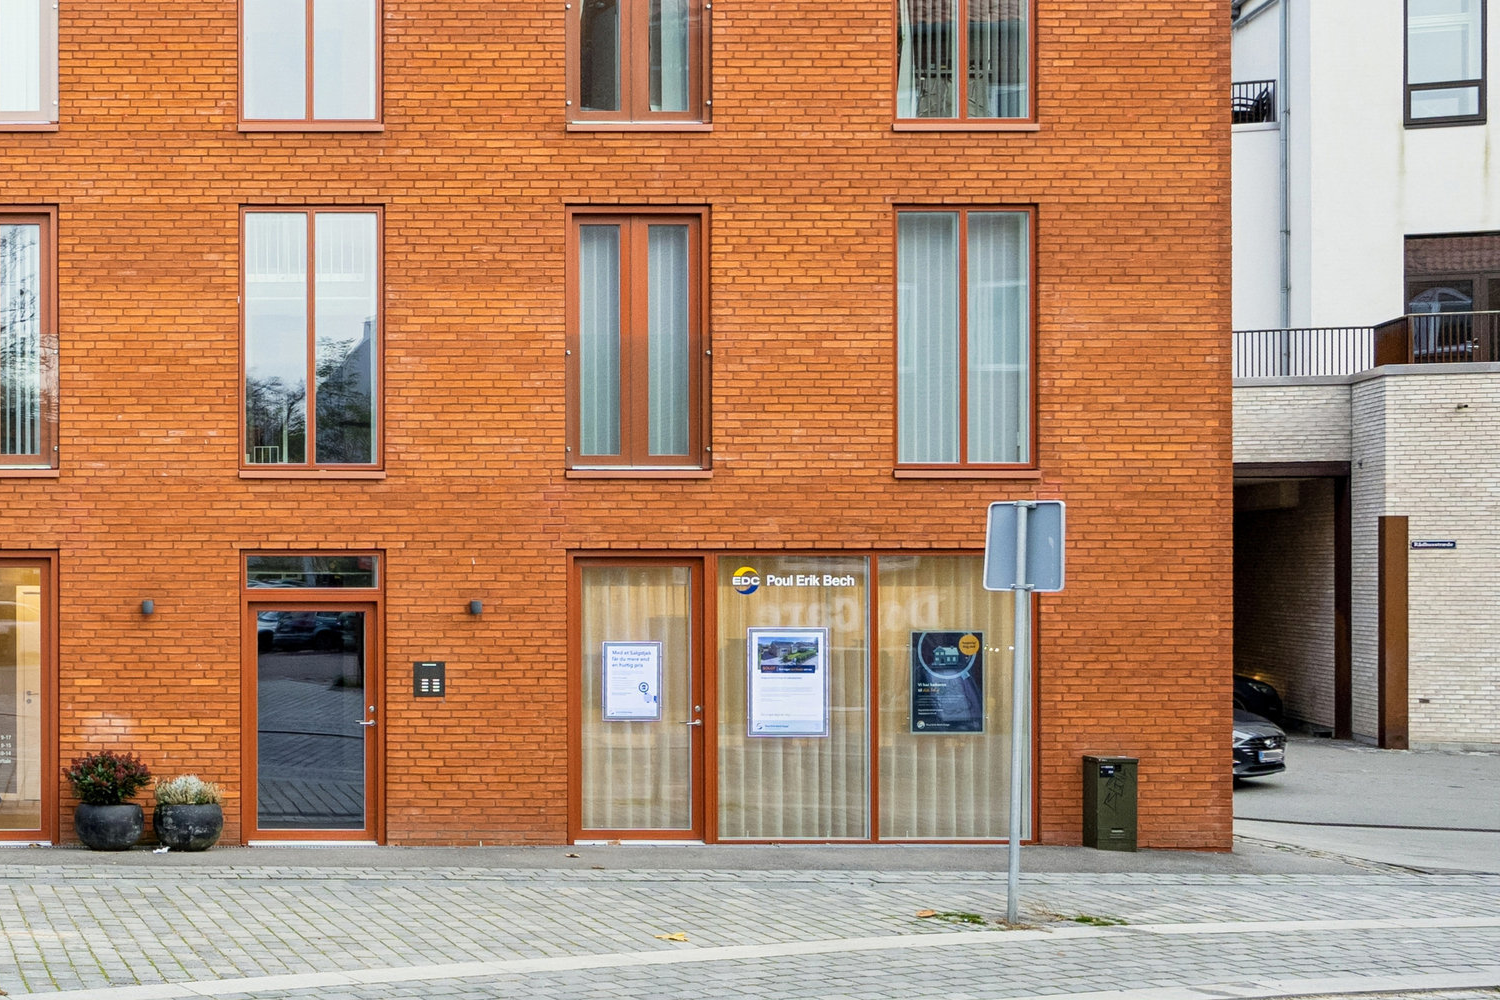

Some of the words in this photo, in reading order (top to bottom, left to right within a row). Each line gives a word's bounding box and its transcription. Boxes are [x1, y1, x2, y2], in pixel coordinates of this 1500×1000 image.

[732, 576, 760, 585] EDC
[766, 574, 793, 586] Poul
[796, 574, 820, 586] Erik
[823, 574, 855, 586] Bech
